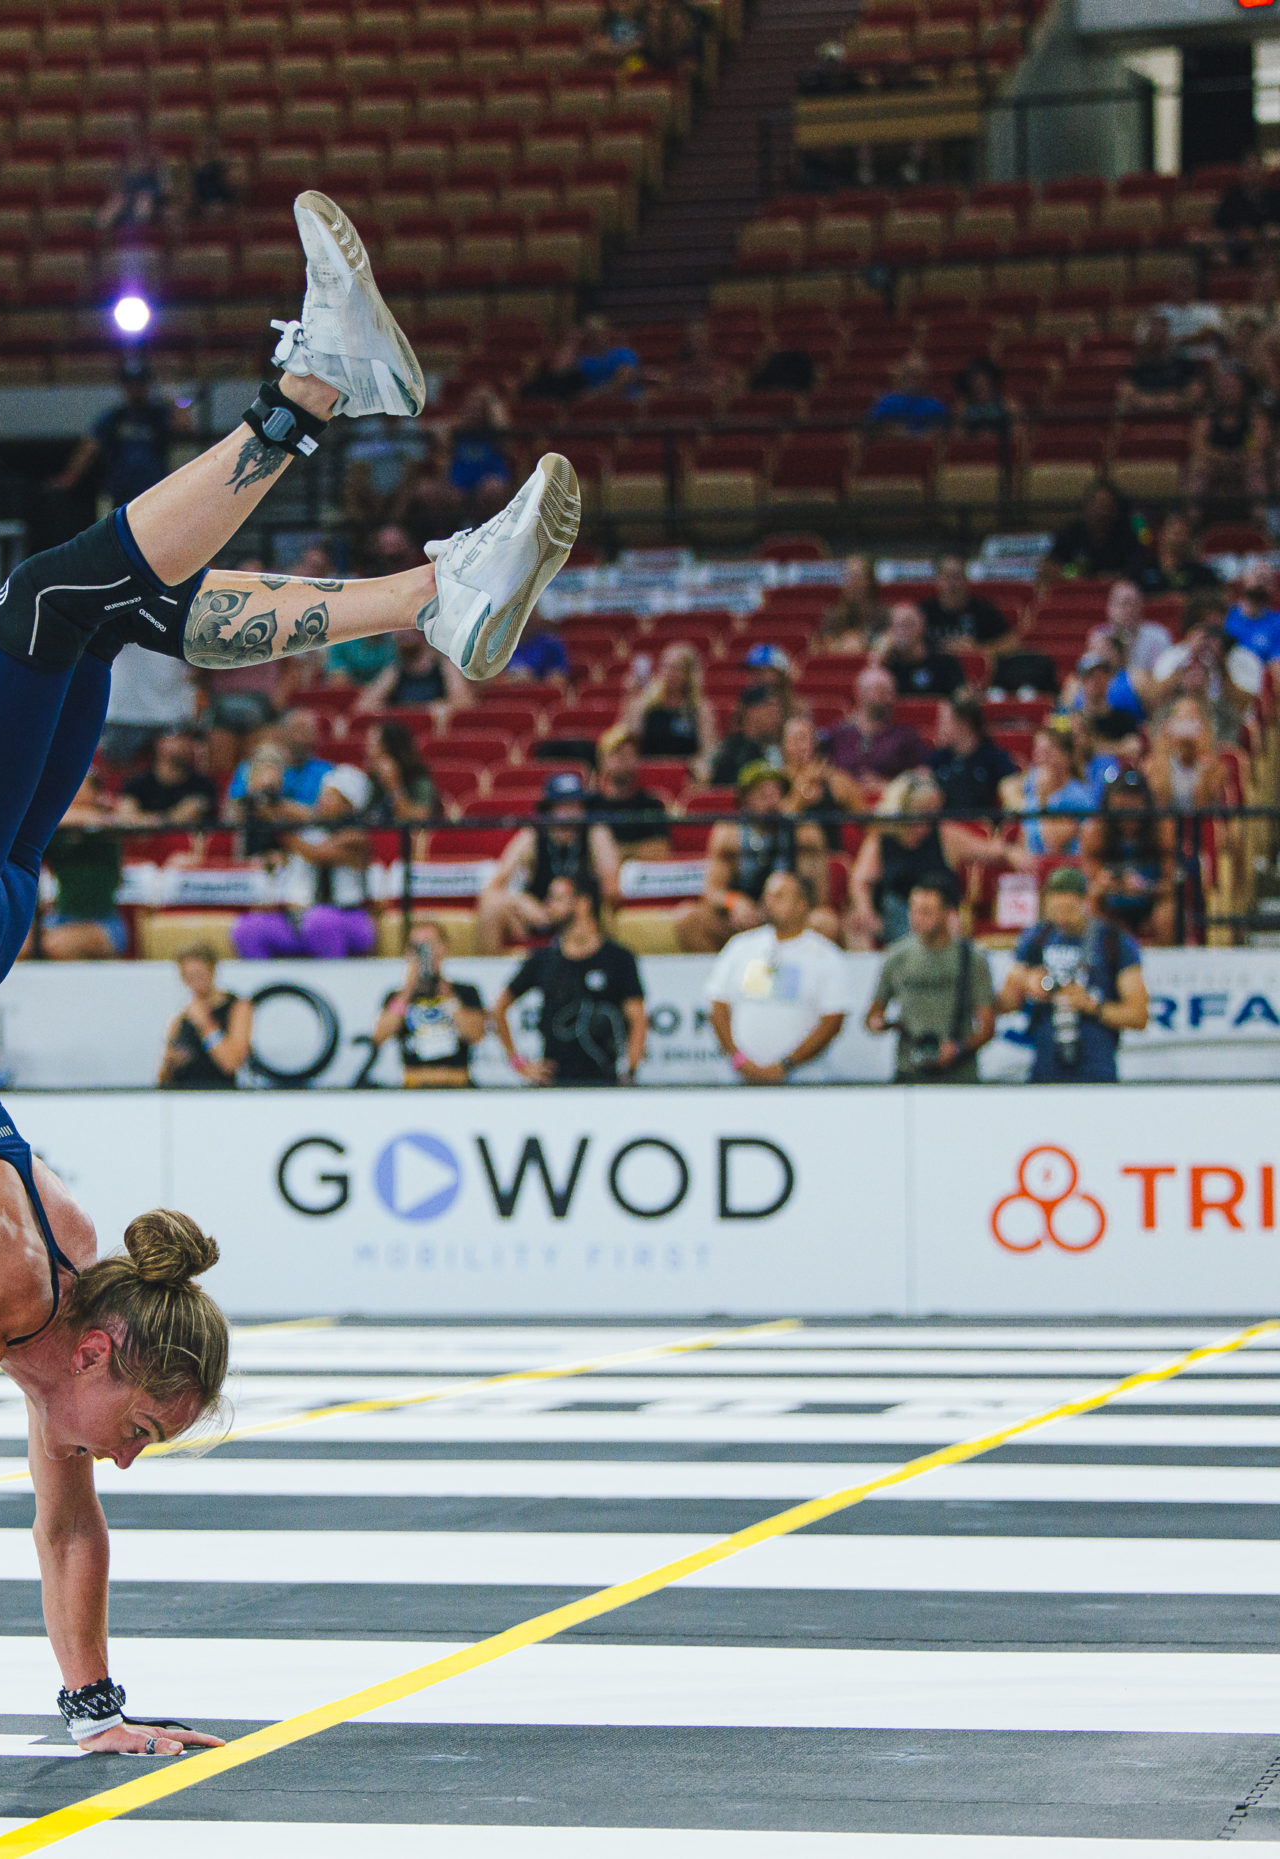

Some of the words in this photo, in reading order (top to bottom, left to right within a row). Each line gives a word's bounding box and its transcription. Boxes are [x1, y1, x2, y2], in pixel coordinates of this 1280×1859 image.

[452, 494, 522, 579] METCON
[277, 1134, 795, 1220] GOWOD
[1122, 1166, 1275, 1229] TRI
[352, 1242, 561, 1269] MOBILITY
[585, 1242, 712, 1269] FIRST
